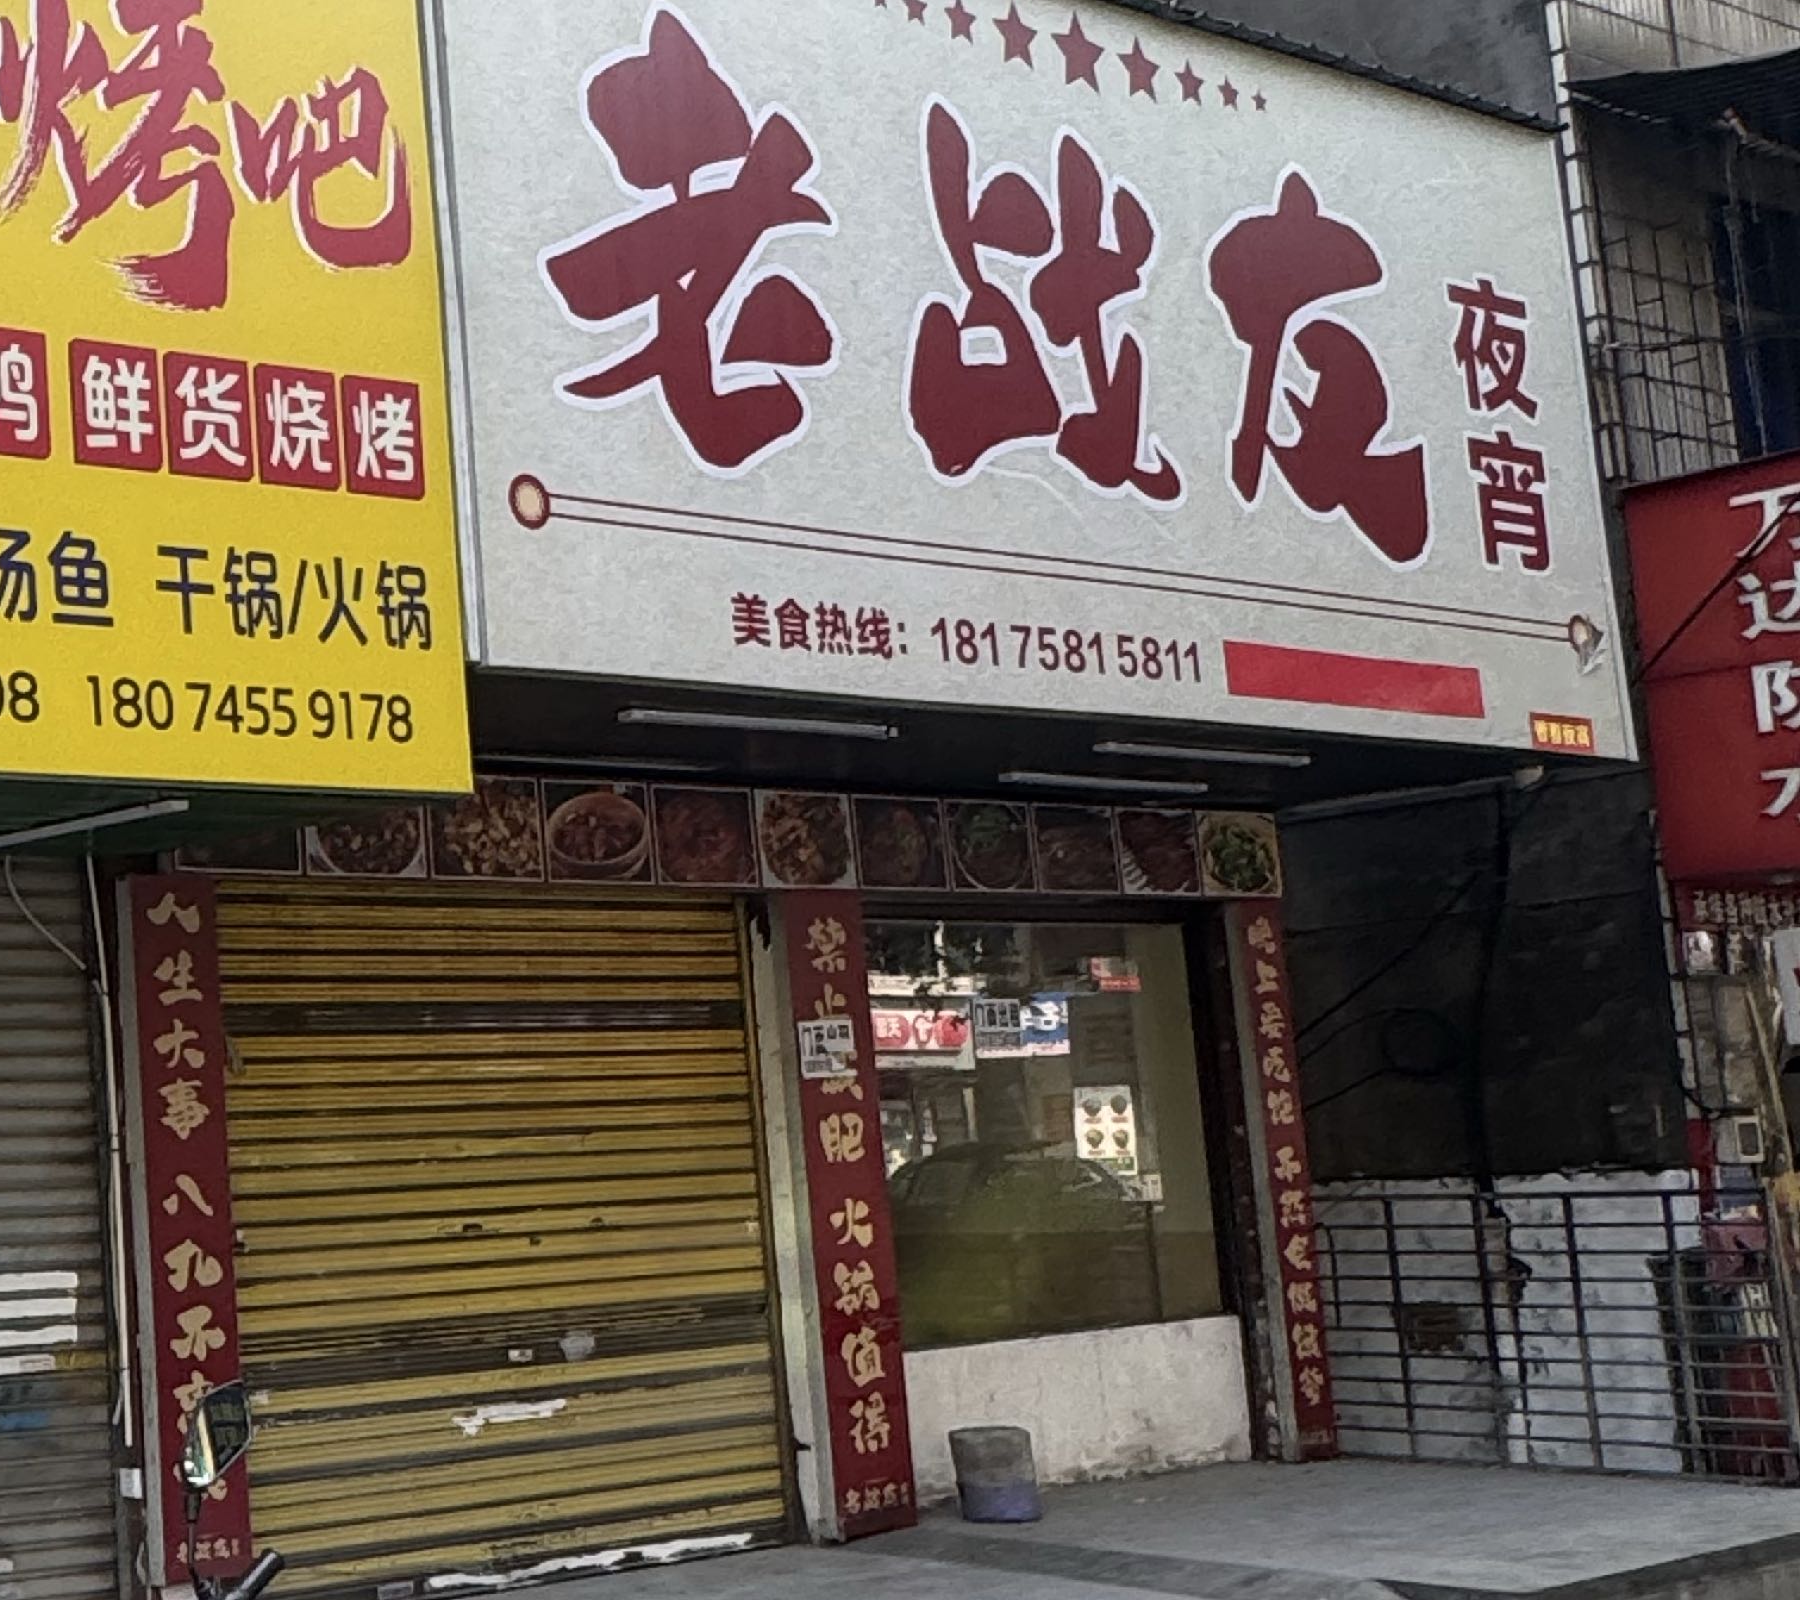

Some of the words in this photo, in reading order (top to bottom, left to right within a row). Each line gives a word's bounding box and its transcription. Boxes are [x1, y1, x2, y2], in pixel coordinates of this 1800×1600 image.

[545, 10, 1432, 564] 老战友
[81, 354, 416, 486] 鲜货烧烤
[1448, 279, 1551, 572] 夜宵
[86, 674, 175, 732] 180
[184, 681, 299, 739] 7455
[307, 688, 415, 745] 9178
[155, 545, 433, 652] 干锅/火锅
[930, 617, 1000, 666] 181
[1010, 625, 1106, 674] 7581
[1117, 634, 1202, 682] 5811
[147, 892, 211, 1140] 人生大事
[162, 1173, 227, 1501] 八九不
[829, 1197, 892, 1456] 火锅值得
